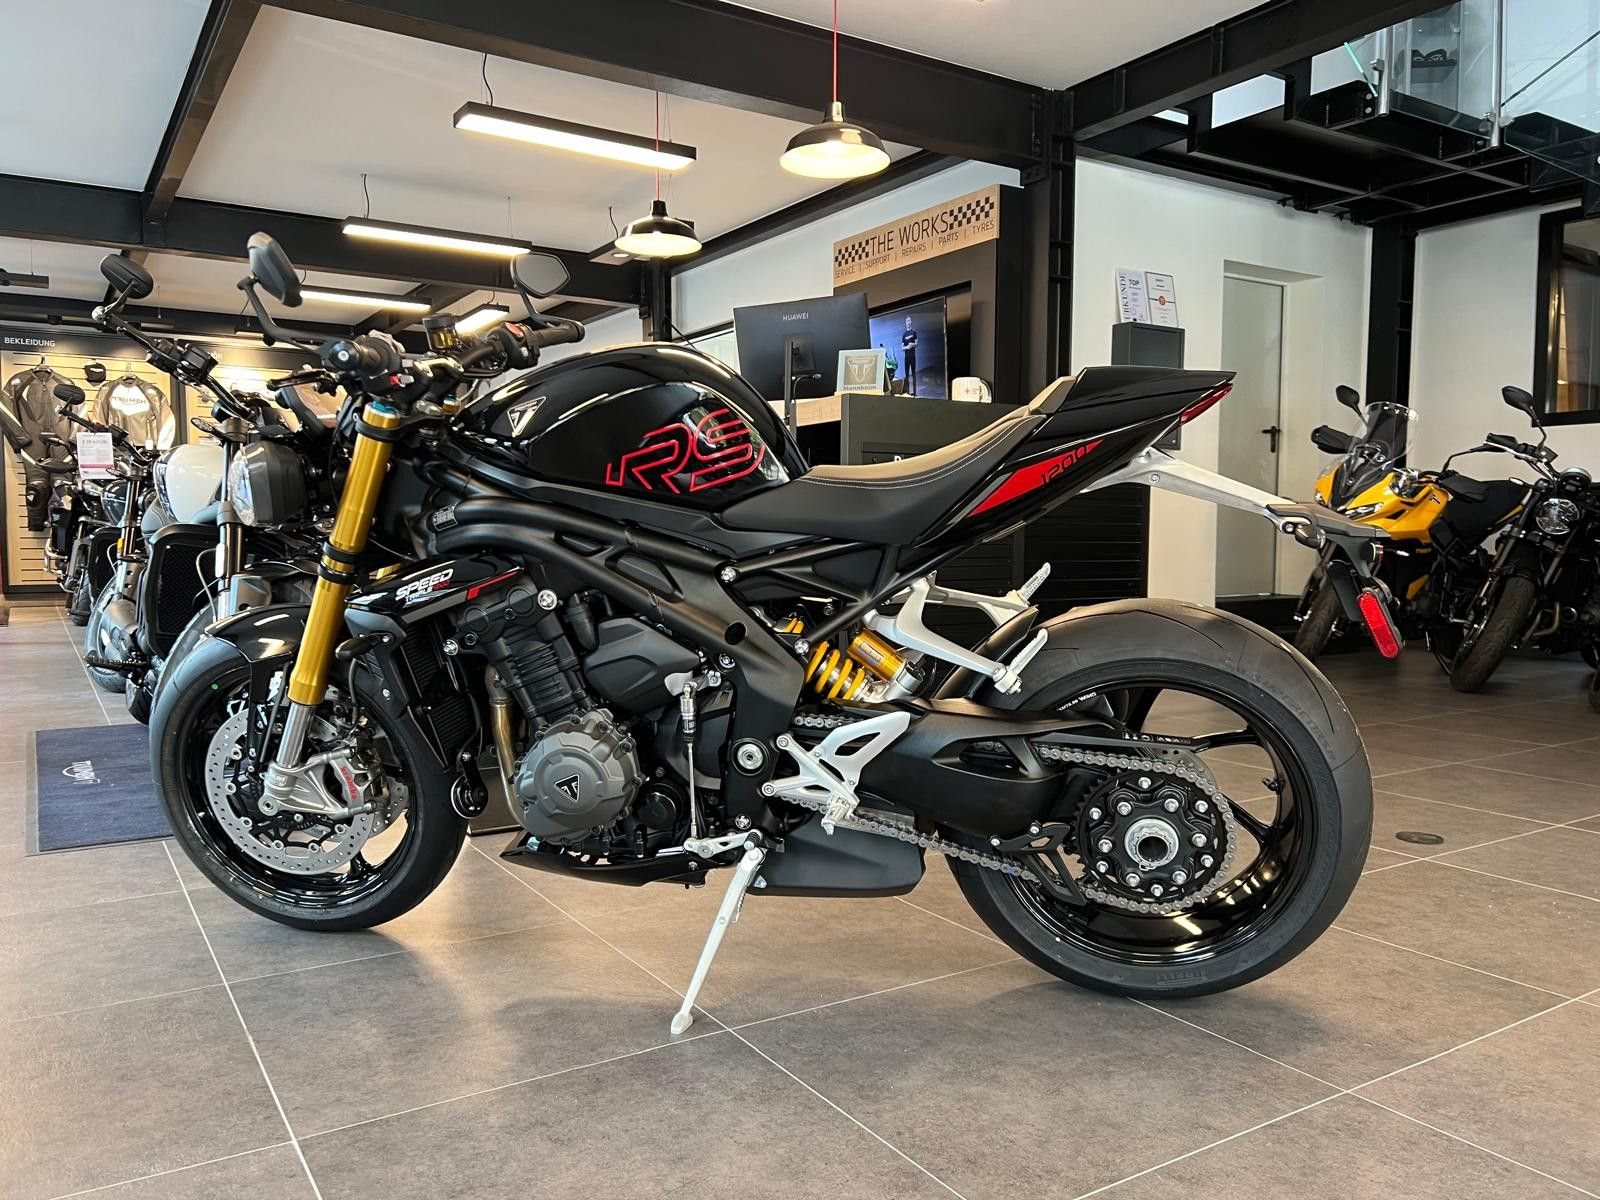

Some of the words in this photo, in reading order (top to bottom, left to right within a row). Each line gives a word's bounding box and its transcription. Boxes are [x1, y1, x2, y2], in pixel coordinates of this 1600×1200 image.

[834, 265, 856, 279] SERVICE
[864, 254, 891, 270] SUPPORT
[901, 243, 927, 257] REPAIRS
[938, 232, 959, 246] PARTS
[972, 221, 995, 235] TYRES
[869, 230, 895, 257] THE
[898, 211, 950, 247] WORKS
[782, 311, 809, 321] HUAWEI
[4, 337, 56, 347] BEKLEIDUNG
[605, 407, 766, 495] RS
[1041, 444, 1088, 485] 1200
[395, 568, 454, 601] SPEED
